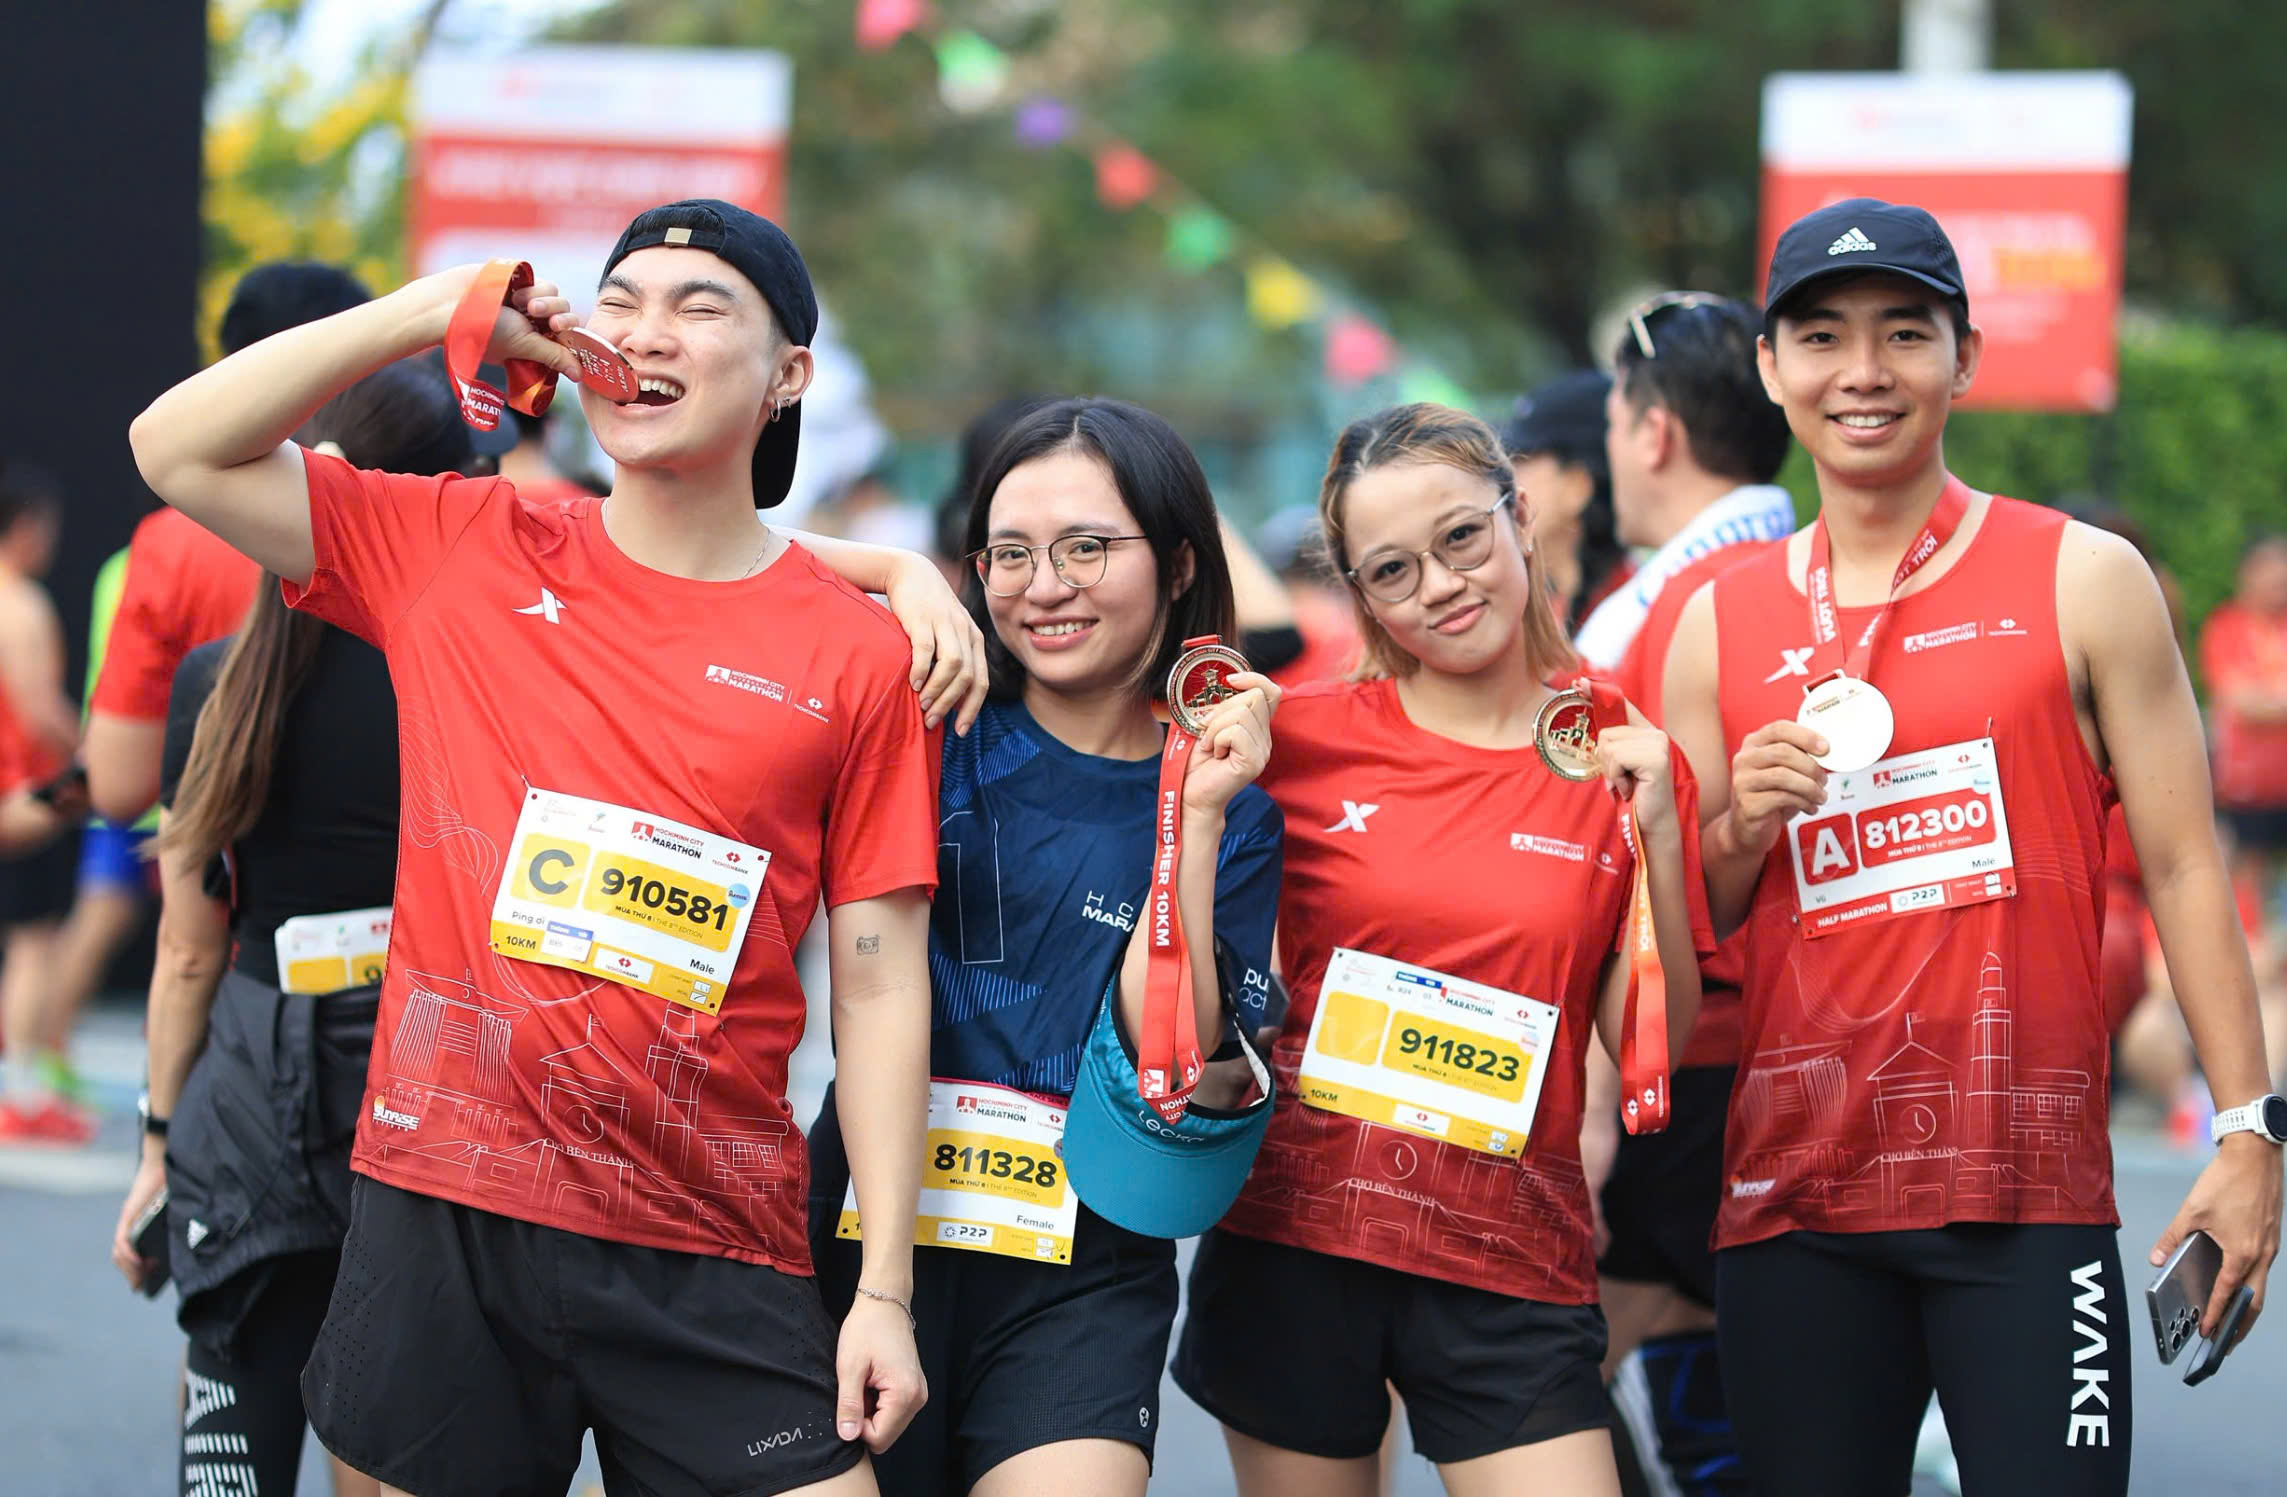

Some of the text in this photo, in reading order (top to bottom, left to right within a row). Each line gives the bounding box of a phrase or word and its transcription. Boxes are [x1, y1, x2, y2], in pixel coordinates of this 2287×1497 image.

[1828, 241, 1877, 255] adidas
[728, 679, 783, 702] MARATHON
[1892, 769, 1938, 785] MARATHON
[1864, 799, 1988, 849] 812300
[651, 837, 702, 859] MARATHON
[689, 837, 705, 847] CITY
[1812, 827, 1851, 876] A
[529, 849, 575, 894] C
[1155, 790, 1175, 947] FINISHER 10KM
[1972, 857, 1996, 869] Male
[600, 868, 729, 932] 910581
[1817, 902, 1889, 928] HALF MARATHON
[505, 935, 537, 950] 10KM
[689, 959, 715, 975] Male
[1445, 997, 1494, 1017] MARATHON
[1400, 1028, 1520, 1082] 911823
[1311, 1088, 1338, 1102] 10KM
[976, 1108, 1027, 1123] MARATHON
[1013, 1104, 1028, 1112] CITY
[934, 1144, 1058, 1188] 811328
[1016, 1214, 1055, 1230] Female
[2066, 1260, 2110, 1447] WAKE
[747, 1427, 803, 1456] LIXADA
